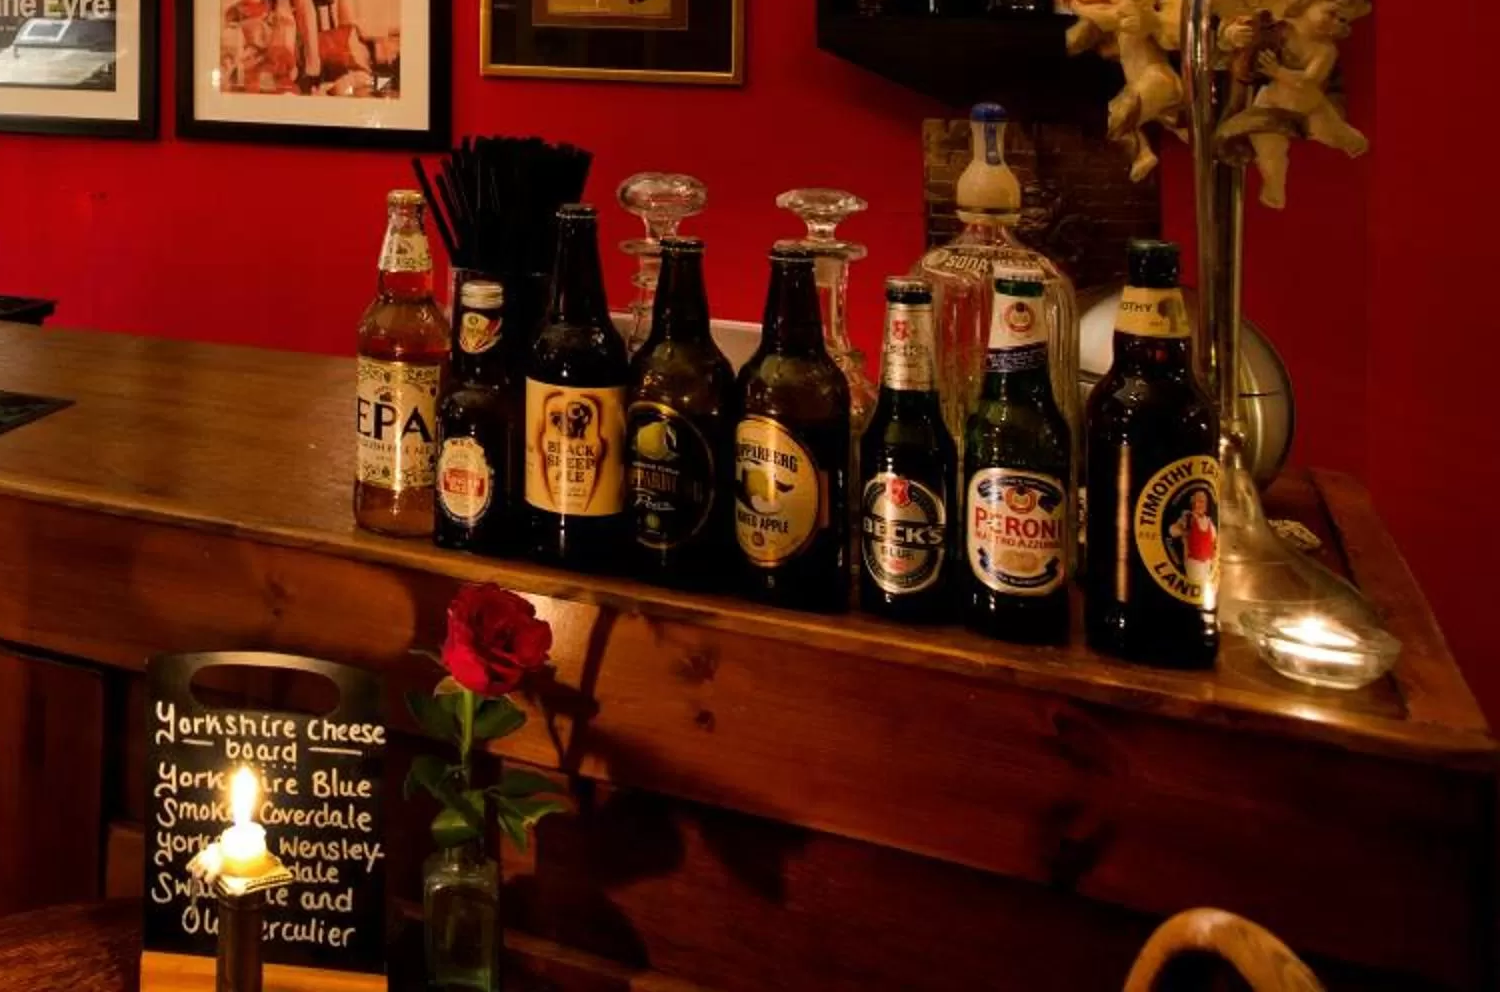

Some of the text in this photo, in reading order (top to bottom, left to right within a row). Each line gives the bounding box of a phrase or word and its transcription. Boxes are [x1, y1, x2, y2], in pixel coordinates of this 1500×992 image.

[357, 395, 434, 443] EPA
[547, 440, 595, 458] BLACK
[547, 454, 596, 471] SHEEP
[554, 469, 585, 484] ALE
[1139, 461, 1194, 526] TIMOTHY
[760, 517, 789, 534] APPLE
[862, 515, 944, 545] BECK'S
[975, 506, 1062, 539] PERONI
[155, 701, 387, 745] Yorkshire Cheese
[225, 739, 298, 763] board
[154, 762, 373, 799] Yorkire Blue
[155, 797, 373, 832] Smok Coverdale
[287, 862, 339, 883] dale
[301, 887, 353, 912] and
[261, 917, 356, 948] rculier
